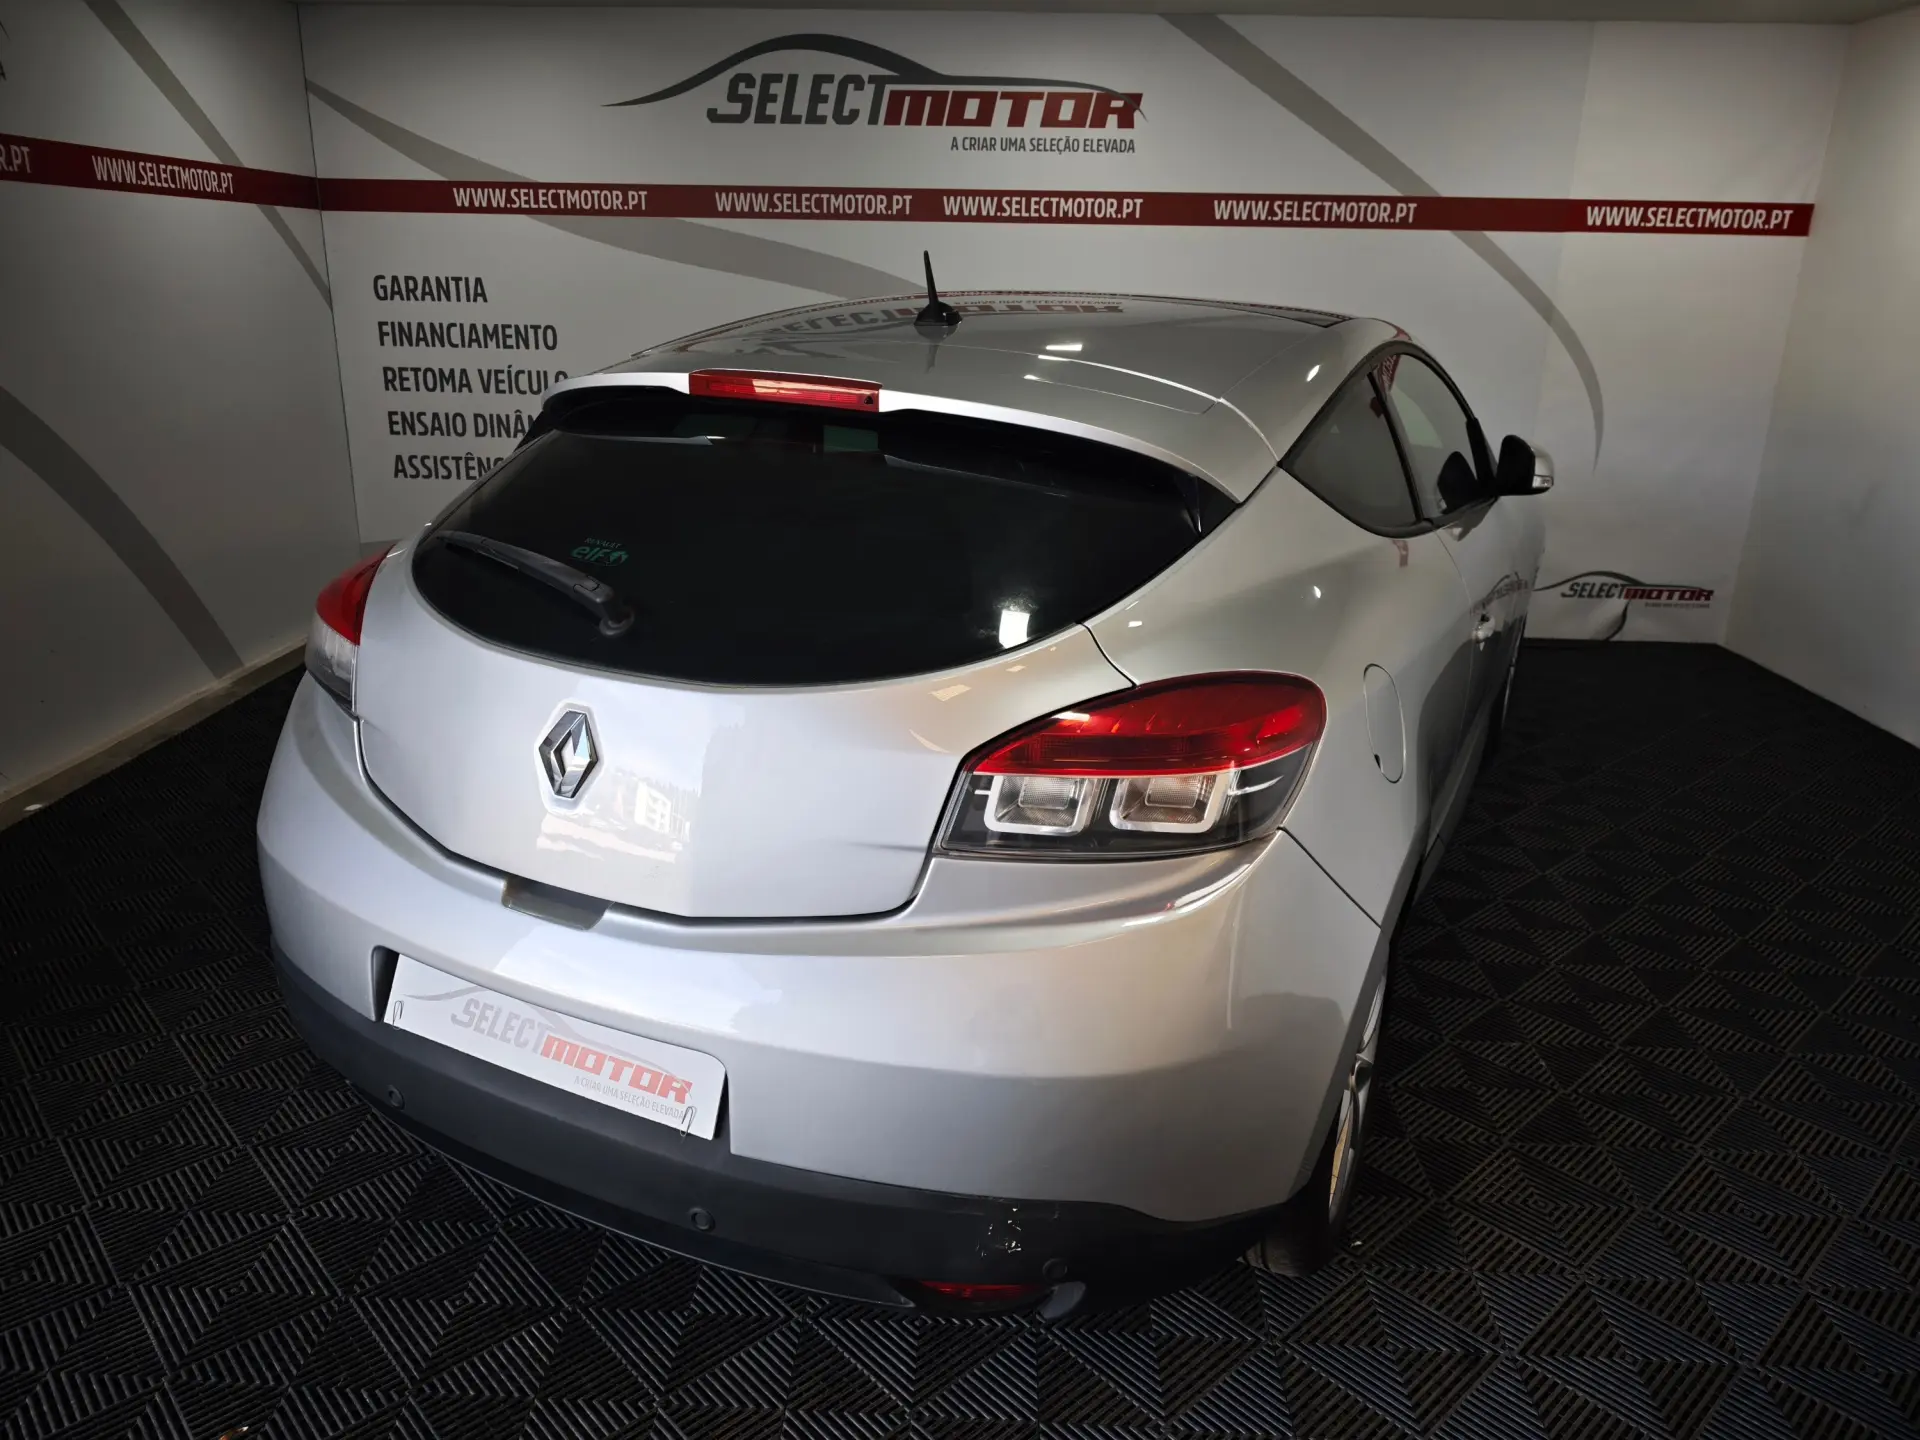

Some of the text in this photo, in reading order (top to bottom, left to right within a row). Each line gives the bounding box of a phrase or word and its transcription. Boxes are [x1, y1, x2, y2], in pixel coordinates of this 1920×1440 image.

[950, 136, 1136, 155] A CRIAR UMA SELEÇÃO ELEVADA
[91, 155, 234, 195] WWW.SELECTMOTOR.PT
[452, 187, 648, 211] WWW.SELECTMOTOR.PT
[715, 191, 913, 215] WWW.SELECTMOTOR.PT
[943, 195, 1144, 219] WWW.SELECTMOTOR.PT
[1213, 199, 1418, 224] WWW.SELECTMOTOR.PT
[1586, 205, 1794, 230] WWW.SELECTMOTOR.PT
[373, 274, 488, 303] GARANTIA
[377, 320, 558, 351] FINANCIAMENTO
[382, 366, 473, 394] RETOMA
[387, 411, 467, 438] ENSAIO
[602, 1083, 619, 1099] UMA
